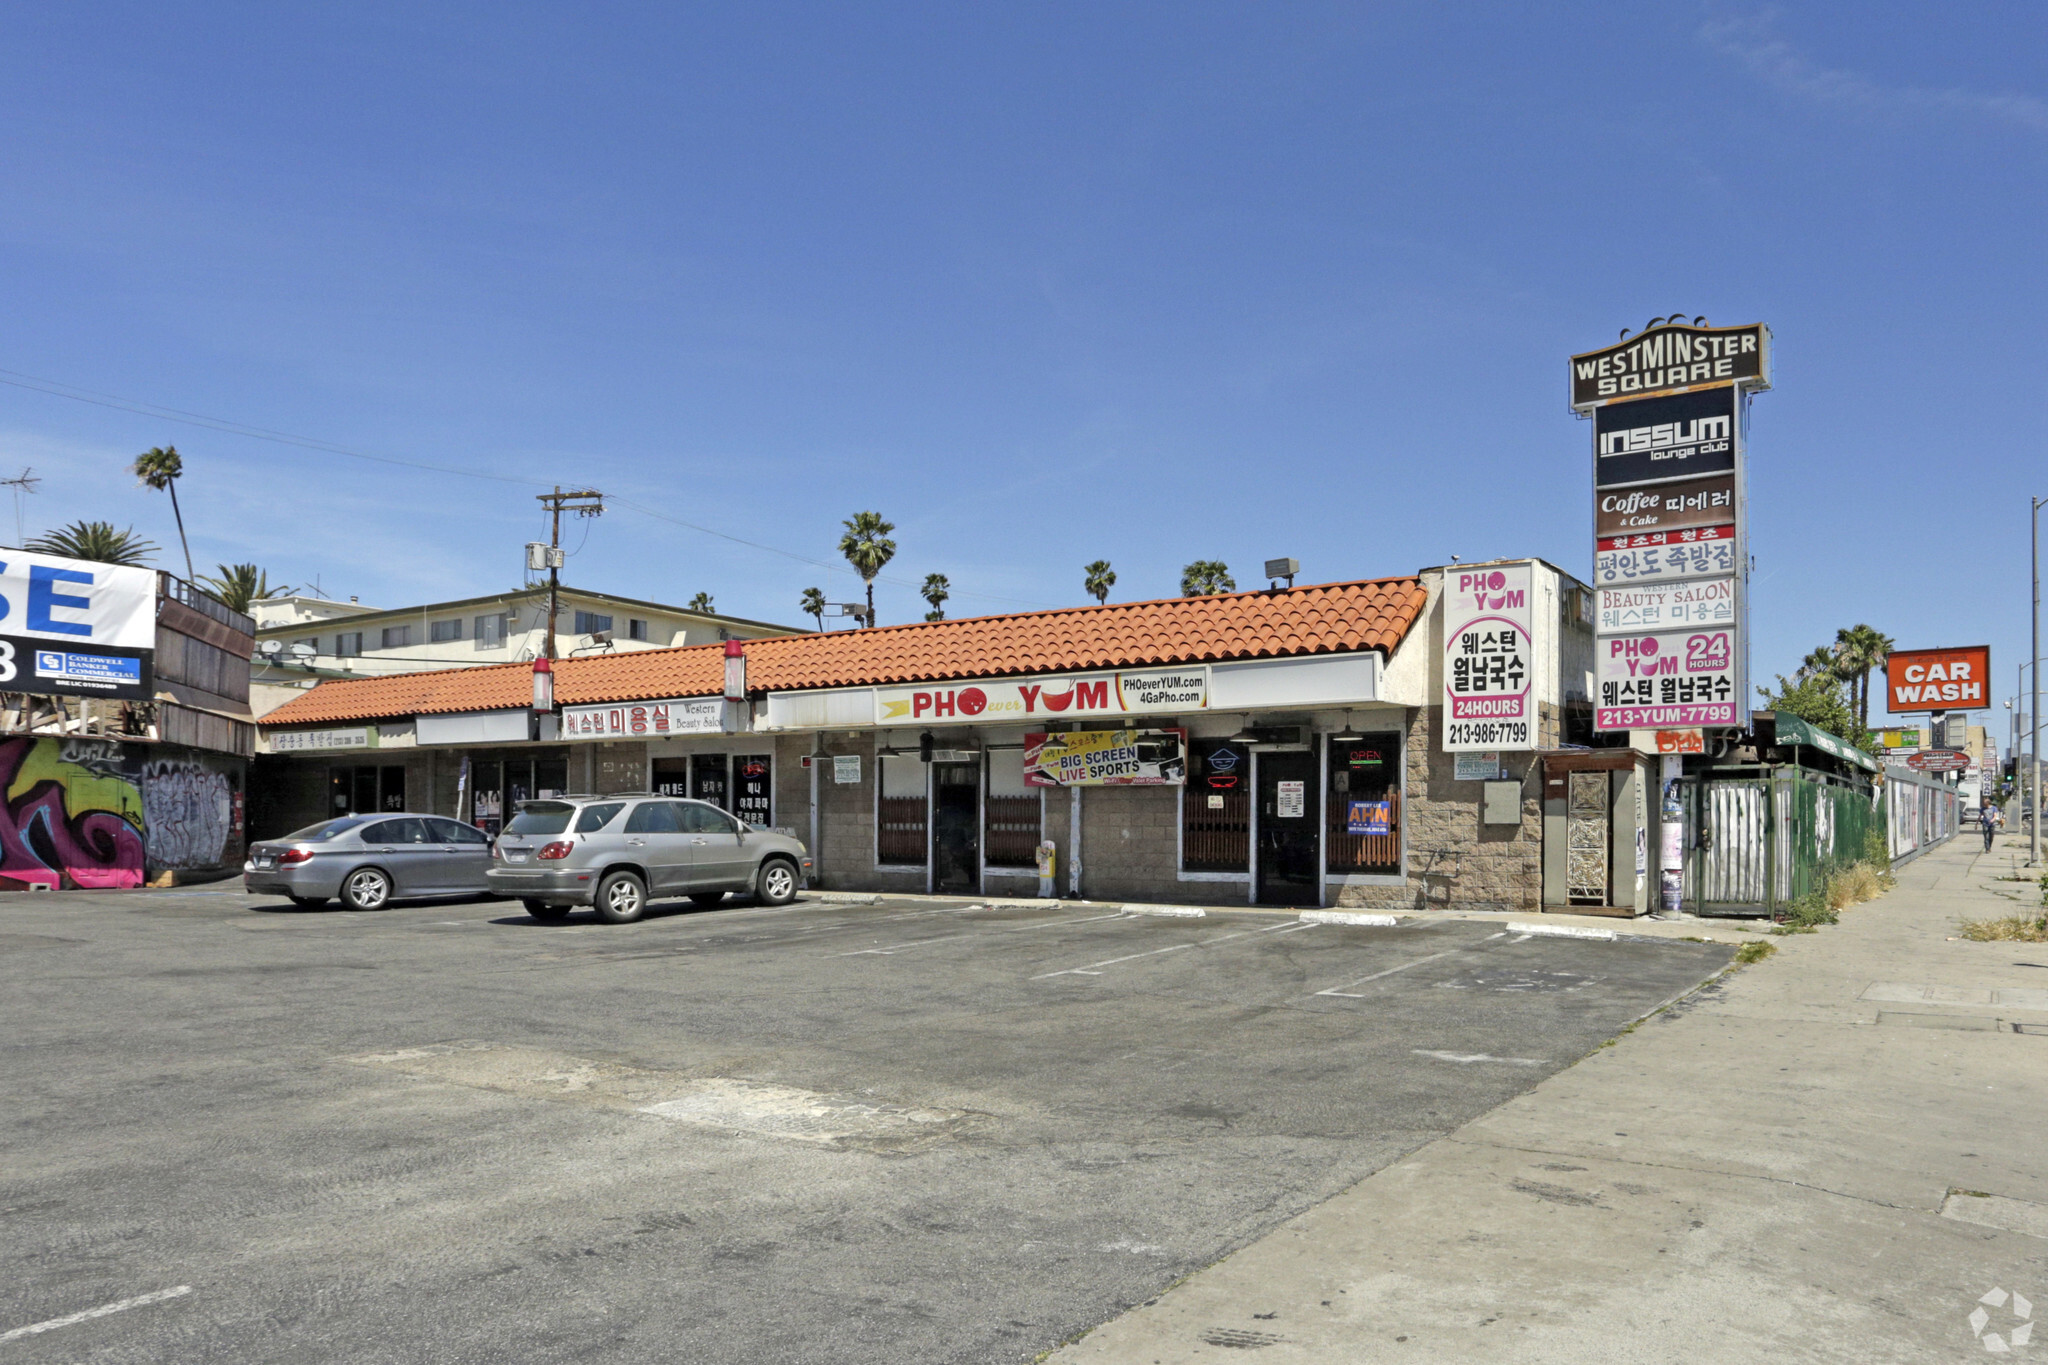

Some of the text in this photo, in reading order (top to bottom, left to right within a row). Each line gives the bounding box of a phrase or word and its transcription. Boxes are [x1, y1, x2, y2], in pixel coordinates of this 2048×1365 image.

[1576, 332, 1756, 381] WESTMINSTER
[1597, 357, 1733, 396] SQUARE
[1650, 442, 1729, 461] lounge club
[1602, 492, 1660, 515] Coffee
[1620, 515, 1658, 527] & Cake
[1612, 528, 1720, 549] 원조의 원조
[1598, 541, 1734, 581] 평안도 족발집
[1460, 571, 1506, 593] PHO
[1643, 581, 1689, 592] WESTERN
[1474, 589, 1524, 611] YUM
[1603, 579, 1732, 609] BEAUTY SALON
[1602, 600, 1732, 627] 웨스턴 미용실
[1462, 630, 1516, 654] 웨스턴
[1611, 636, 1659, 658] PHO
[1690, 635, 1727, 660] 24
[68, 655, 124, 666] COLDWELL
[68, 661, 109, 671] BANKER
[1627, 655, 1678, 677] YUM
[1690, 659, 1726, 669] HOURS
[68, 668, 136, 679] COMMERCIAL
[1123, 676, 1203, 691] PHOeverYUM.com
[1454, 655, 1524, 692] 월남국수
[1905, 662, 1972, 683] CAR
[913, 681, 1108, 719] PHO ever YUM
[1139, 690, 1200, 705] 4GaPho.com
[1602, 676, 1731, 706] 웨스턴 월남국수
[1894, 682, 1981, 704] WASH
[567, 704, 670, 734] 웨스턴 미용실
[684, 703, 715, 715] Western
[1456, 700, 1520, 716] 24HOURS
[1602, 705, 1732, 726] 213-YUM-7799
[676, 716, 724, 730] Beauty Salon
[1449, 722, 1527, 744] 213-986-7799
[1060, 754, 1082, 769] BIG
[1085, 746, 1136, 765] SCREEN
[1349, 750, 1382, 761] OPEN
[1059, 768, 1086, 782] LIVE
[1090, 760, 1140, 778] SPORTS
[1348, 807, 1389, 823] AHN
